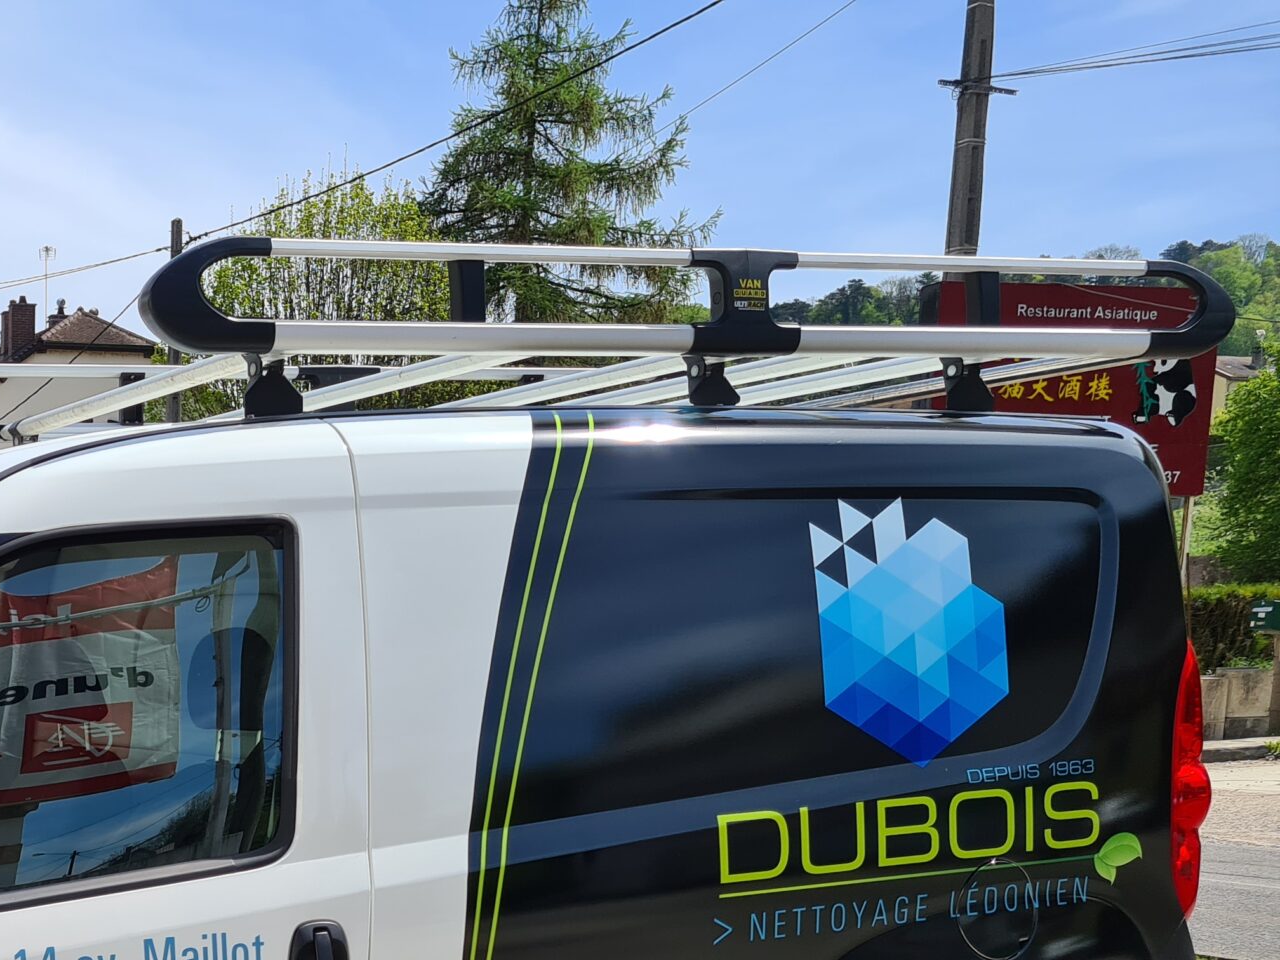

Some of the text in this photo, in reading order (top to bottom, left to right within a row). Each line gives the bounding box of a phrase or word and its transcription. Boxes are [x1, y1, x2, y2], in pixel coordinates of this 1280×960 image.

[734, 289, 766, 298] GUARD
[739, 279, 761, 288] VAN
[1017, 303, 1158, 322] Restaurant Asiatique
[966, 758, 1095, 784] DEPUIS 1963
[716, 780, 1100, 884] DUBOIS
[749, 875, 1090, 941] NETTOYAGE LÉDONIEN
